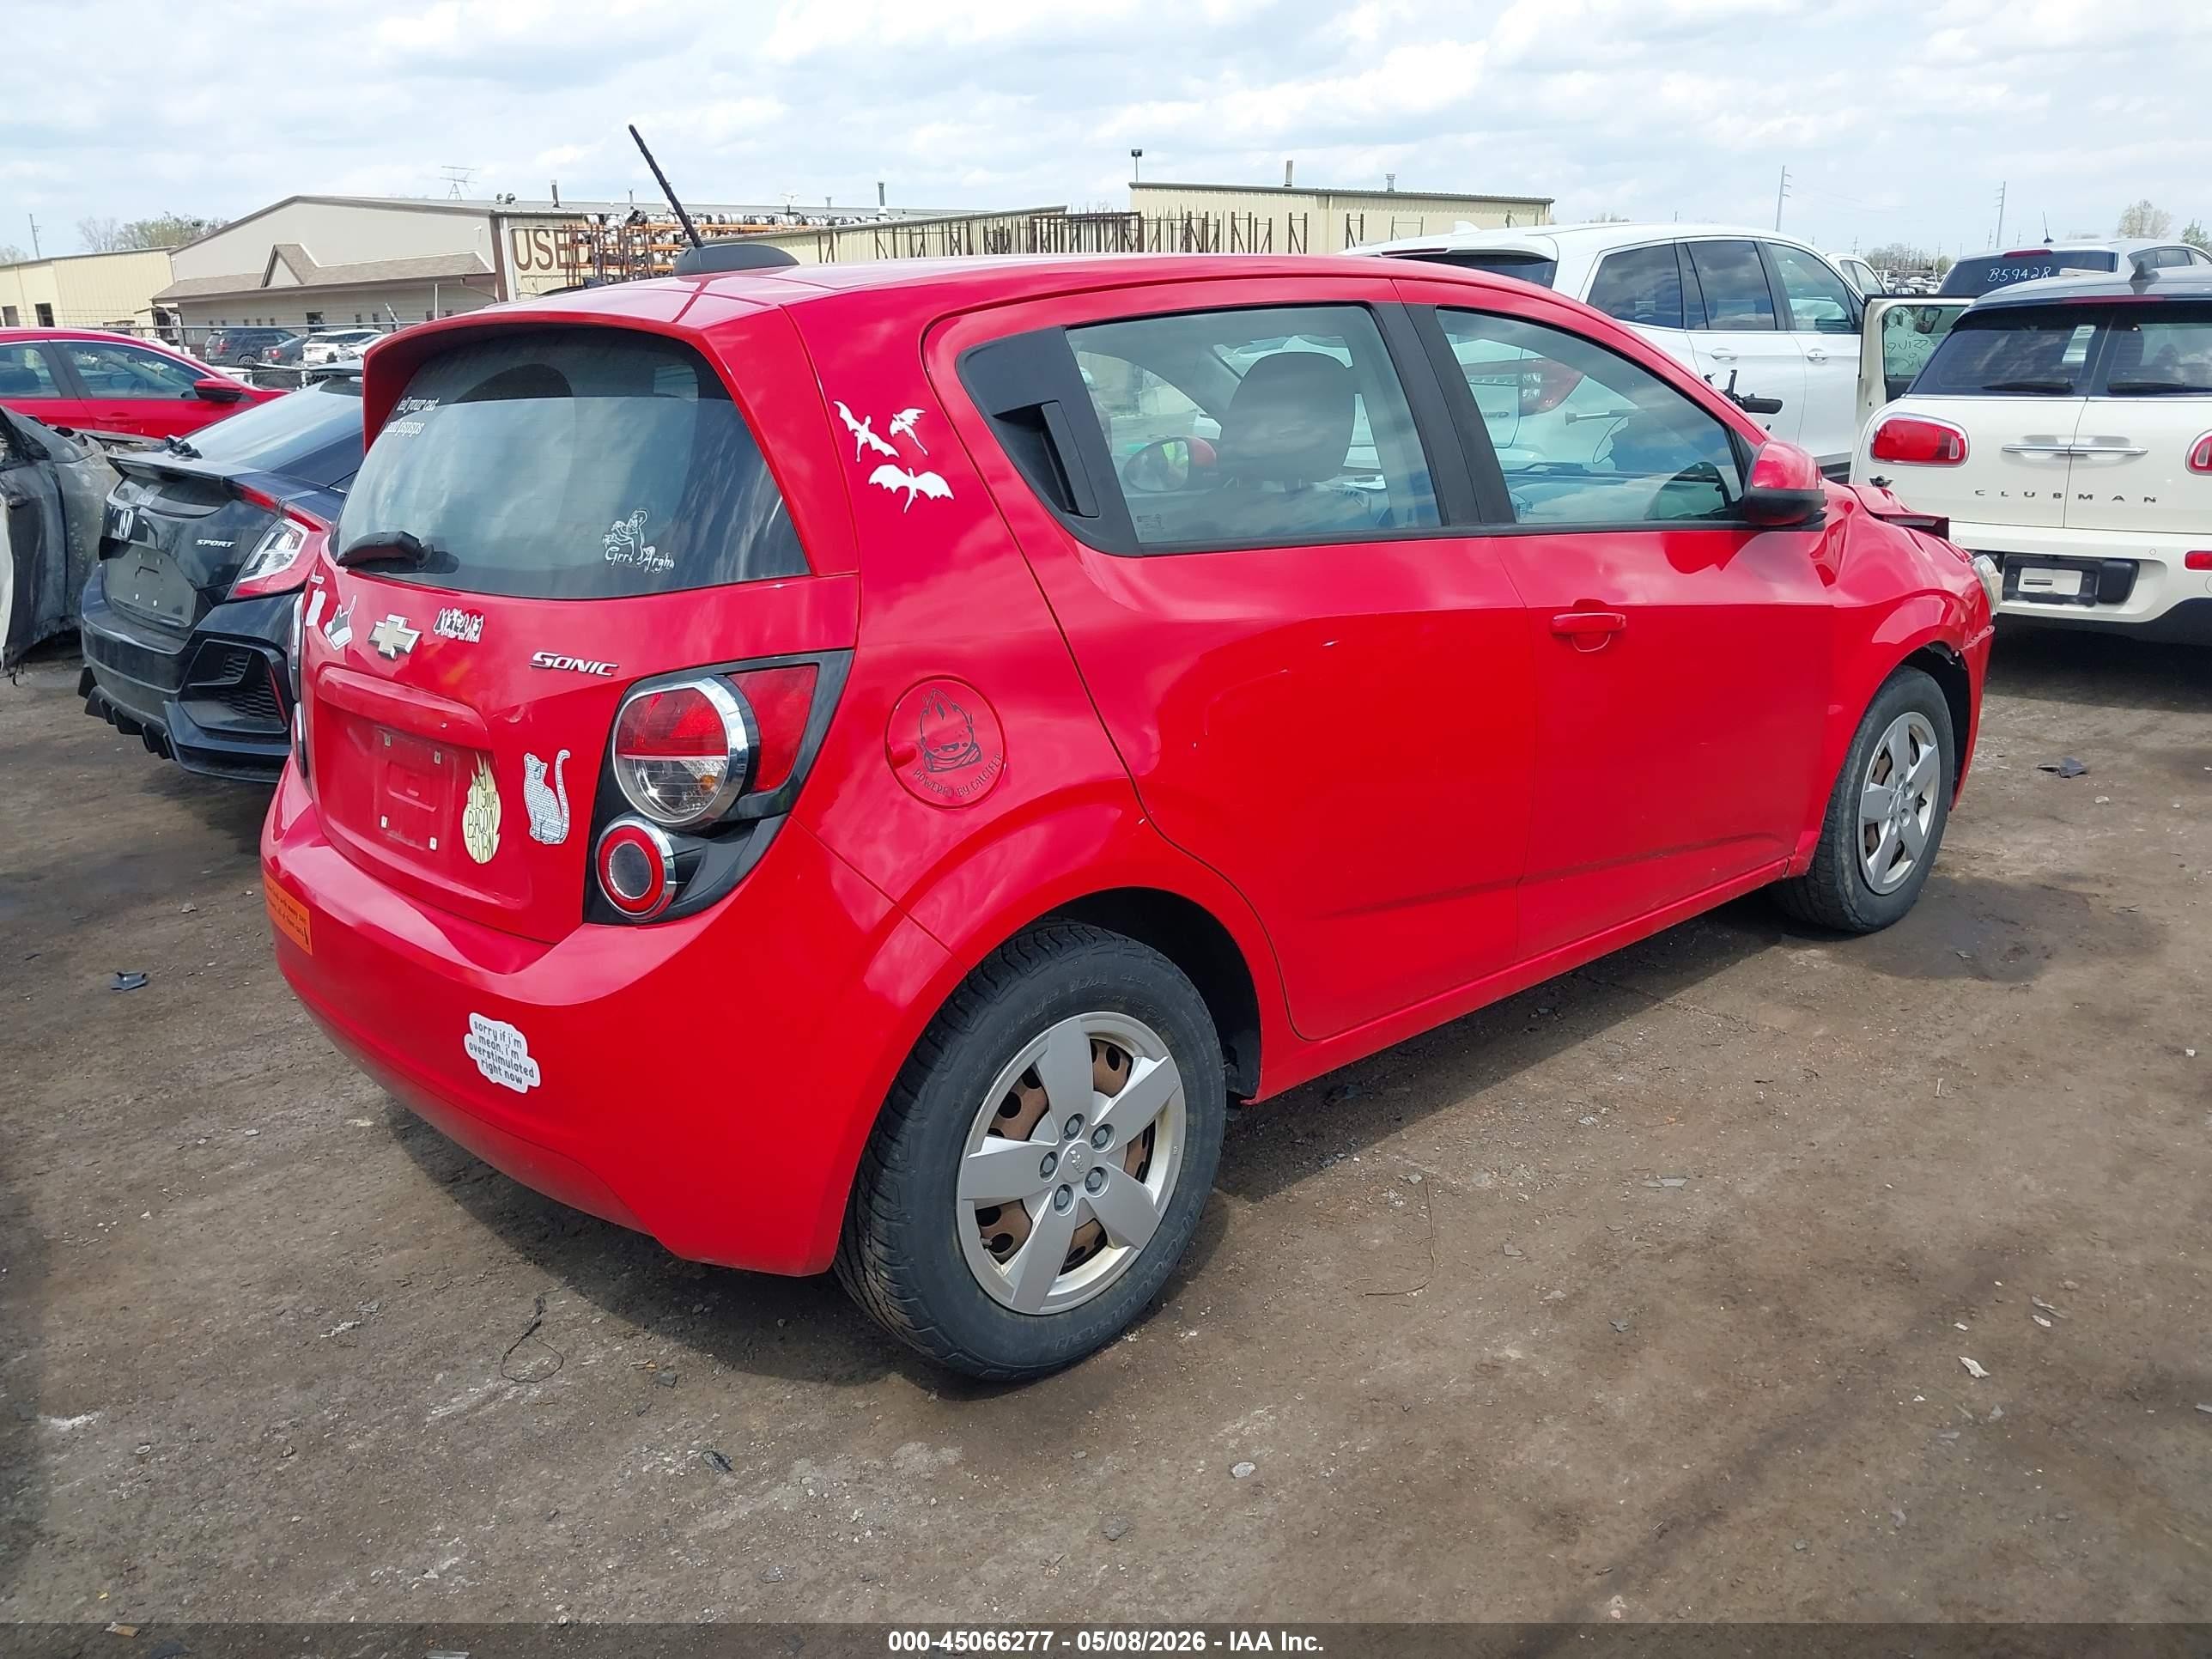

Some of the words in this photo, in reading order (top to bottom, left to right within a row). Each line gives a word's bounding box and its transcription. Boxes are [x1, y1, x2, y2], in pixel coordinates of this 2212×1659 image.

[404, 399, 428, 414] your
[422, 397, 440, 411] cat
[1974, 489, 2157, 503] CLUBMAN
[195, 539, 236, 548] SPORT
[529, 652, 618, 677] SONIC
[957, 785, 969, 797] BY
[467, 807, 496, 838] BACON
[471, 831, 495, 861] BURN
[473, 1020, 498, 1042] sorry
[500, 1030, 506, 1042] if
[478, 1036, 504, 1054] mean,
[468, 1042, 535, 1079] overstimulated
[481, 1059, 502, 1077] right
[504, 1070, 523, 1085] now
